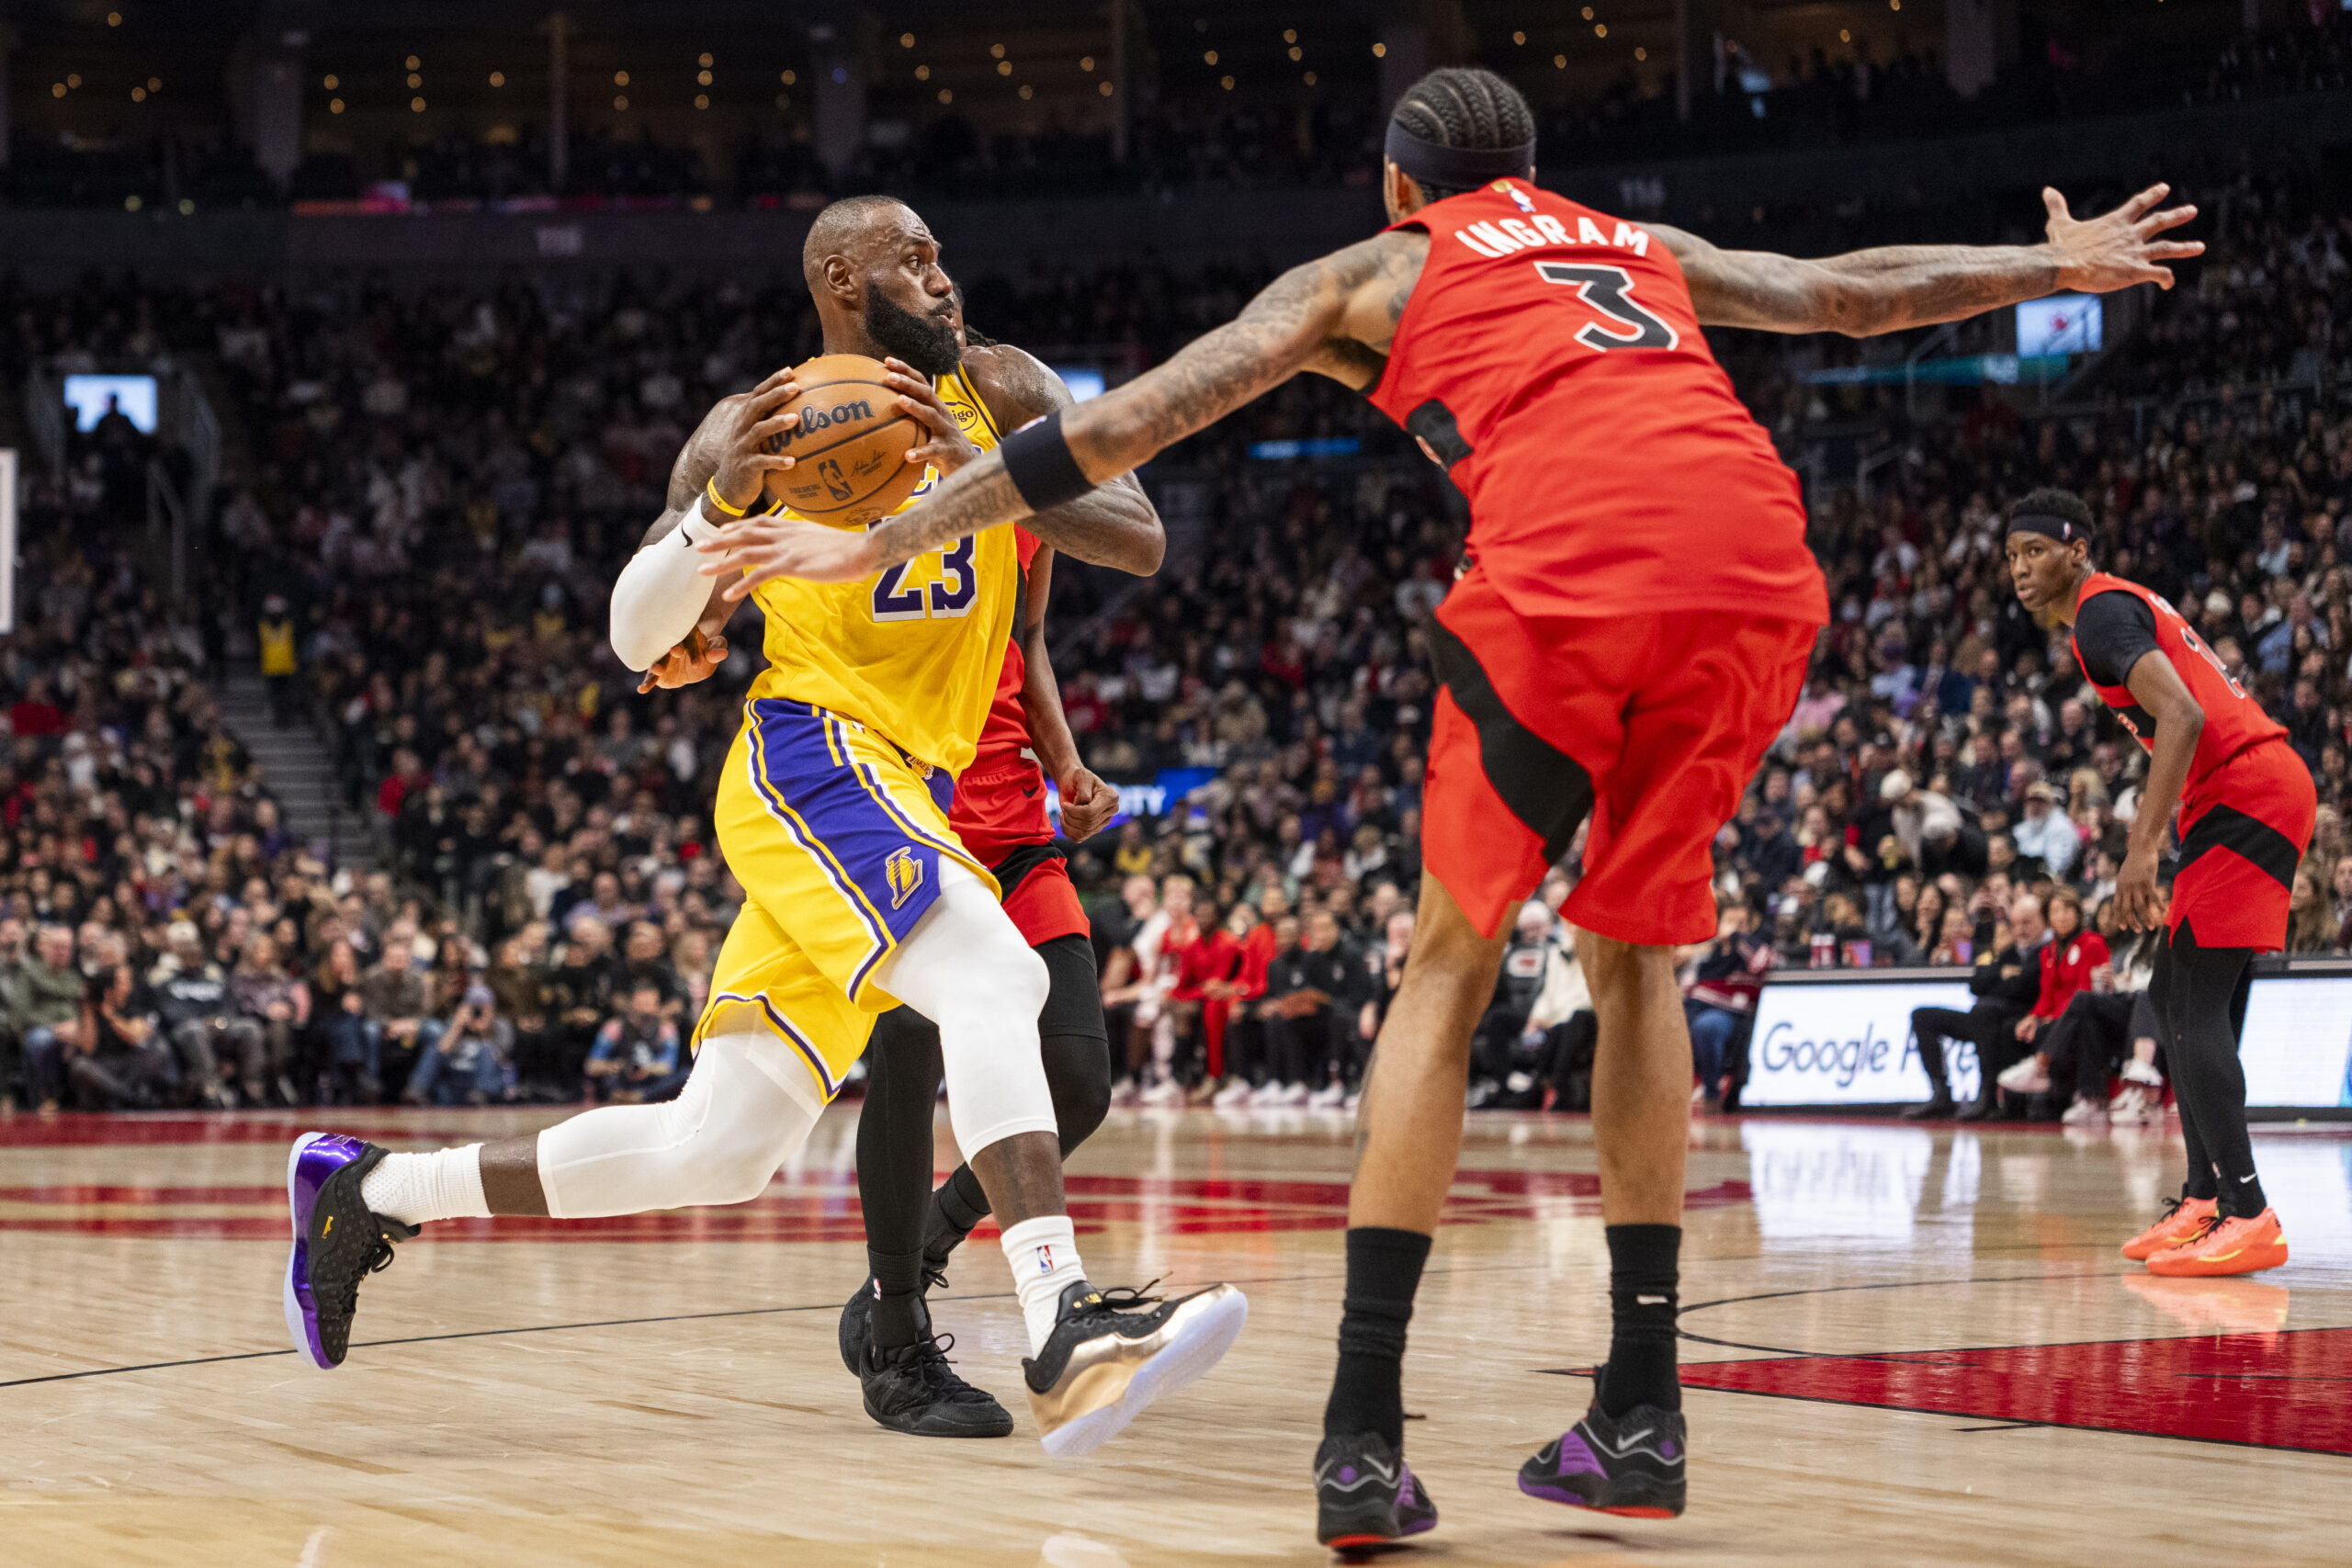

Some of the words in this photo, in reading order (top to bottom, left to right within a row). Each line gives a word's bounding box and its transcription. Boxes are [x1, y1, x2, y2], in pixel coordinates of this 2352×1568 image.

[1454, 214, 1649, 258] INGRAM
[1533, 261, 1679, 353] 3
[1762, 1021, 1890, 1088] Google
